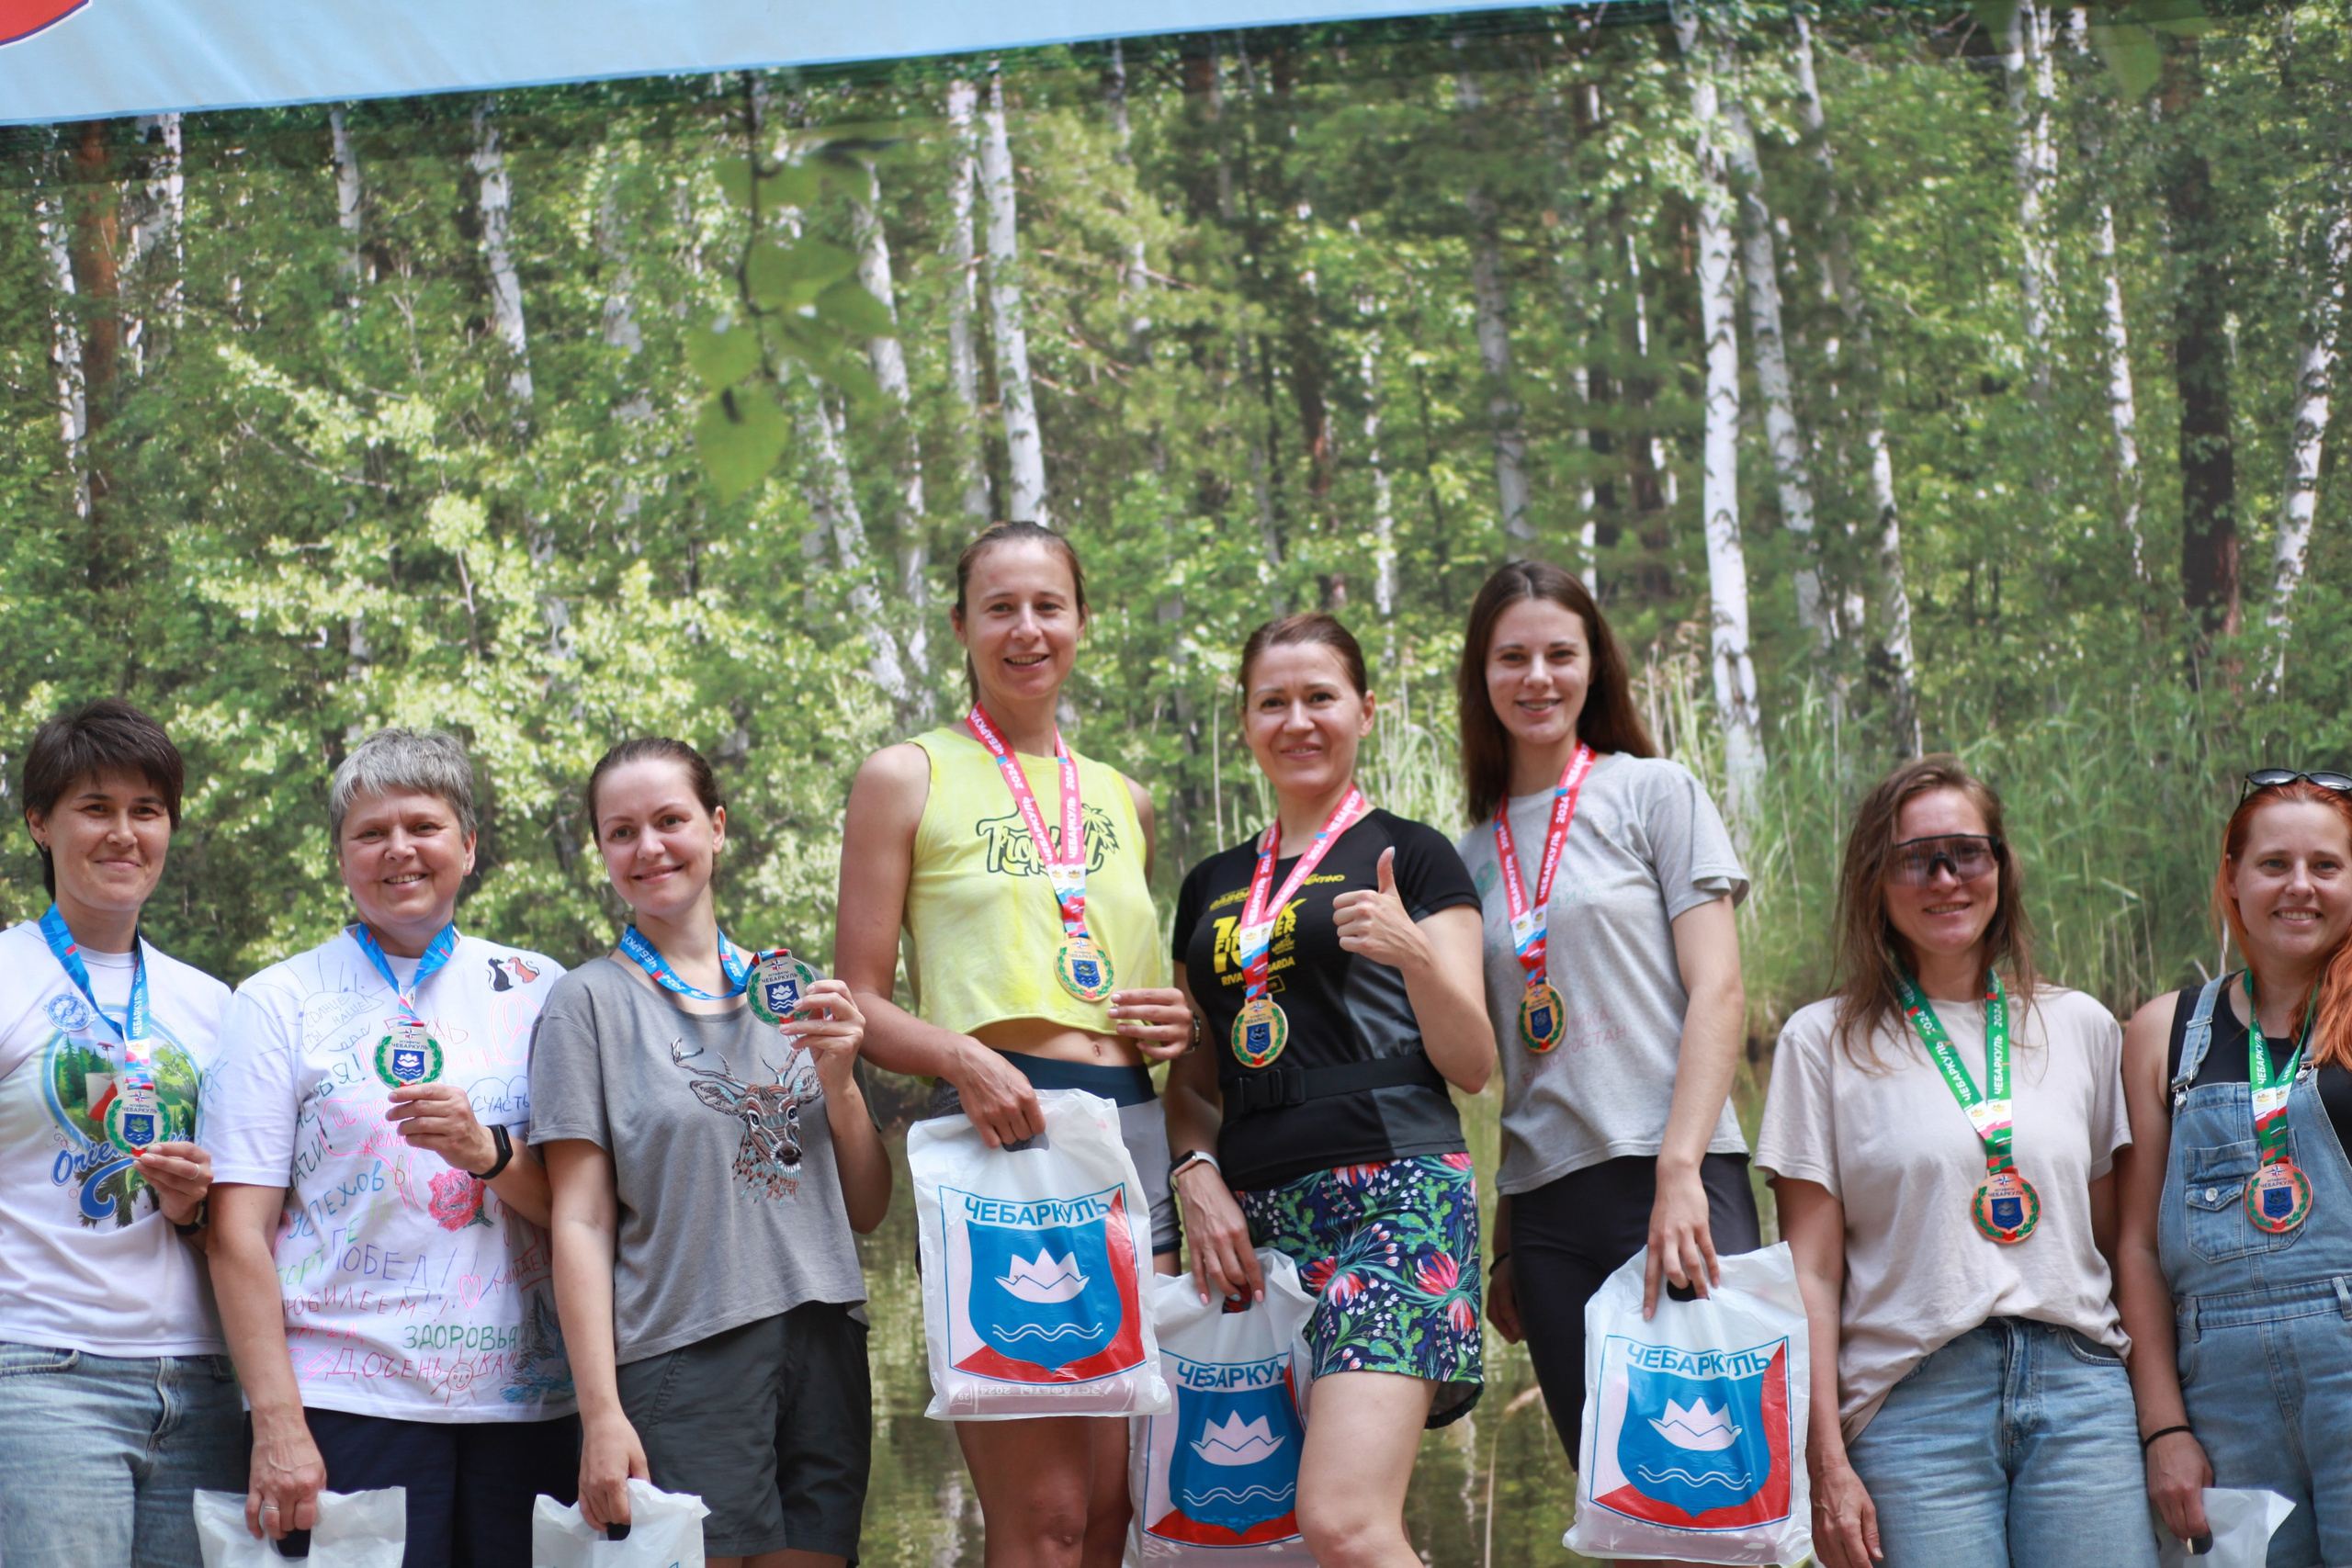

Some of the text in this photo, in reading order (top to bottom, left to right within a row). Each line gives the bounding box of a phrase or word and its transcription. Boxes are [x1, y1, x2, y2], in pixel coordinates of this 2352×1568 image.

[1006, 763, 1053, 862] ЧЕБАРКУЛЬ 2024
[1064, 765, 1080, 860] ЧЕБАРКУЛЬ 2024
[1555, 796, 1570, 824] 2024
[761, 973, 798, 984] ЧЕБАРКУЛЬ
[132, 987, 142, 1036] ЧЕБАРКУЛЬ
[1993, 1002, 2003, 1027] 2024
[391, 1043, 429, 1051] ЧЕБАРКУЛЬ
[2254, 1031, 2267, 1085] ЧЕБАРКУЛЬ
[1935, 1041, 1972, 1101] ЧЕБАРКУЛЬ
[1994, 1034, 2003, 1094] ЧЕБАРКУЛЬ
[121, 1106, 158, 1114] ЧЕБАРКУЛЬ
[471, 1093, 530, 1113] СЧАСТЬ
[2260, 1179, 2295, 1189] ЧЕБАРКУЛЬ
[964, 1197, 1112, 1228] ЧЕБАРКУЛЬ
[401, 1325, 519, 1351] ЗДОРОВЬЯ
[1626, 1342, 1772, 1377] ЧЕБАРКУЛЬ
[1177, 1360, 1285, 1388] ЧЕБАРКУ
[979, 1385, 1101, 1395] ЭСТАФЕТЫ 2024
